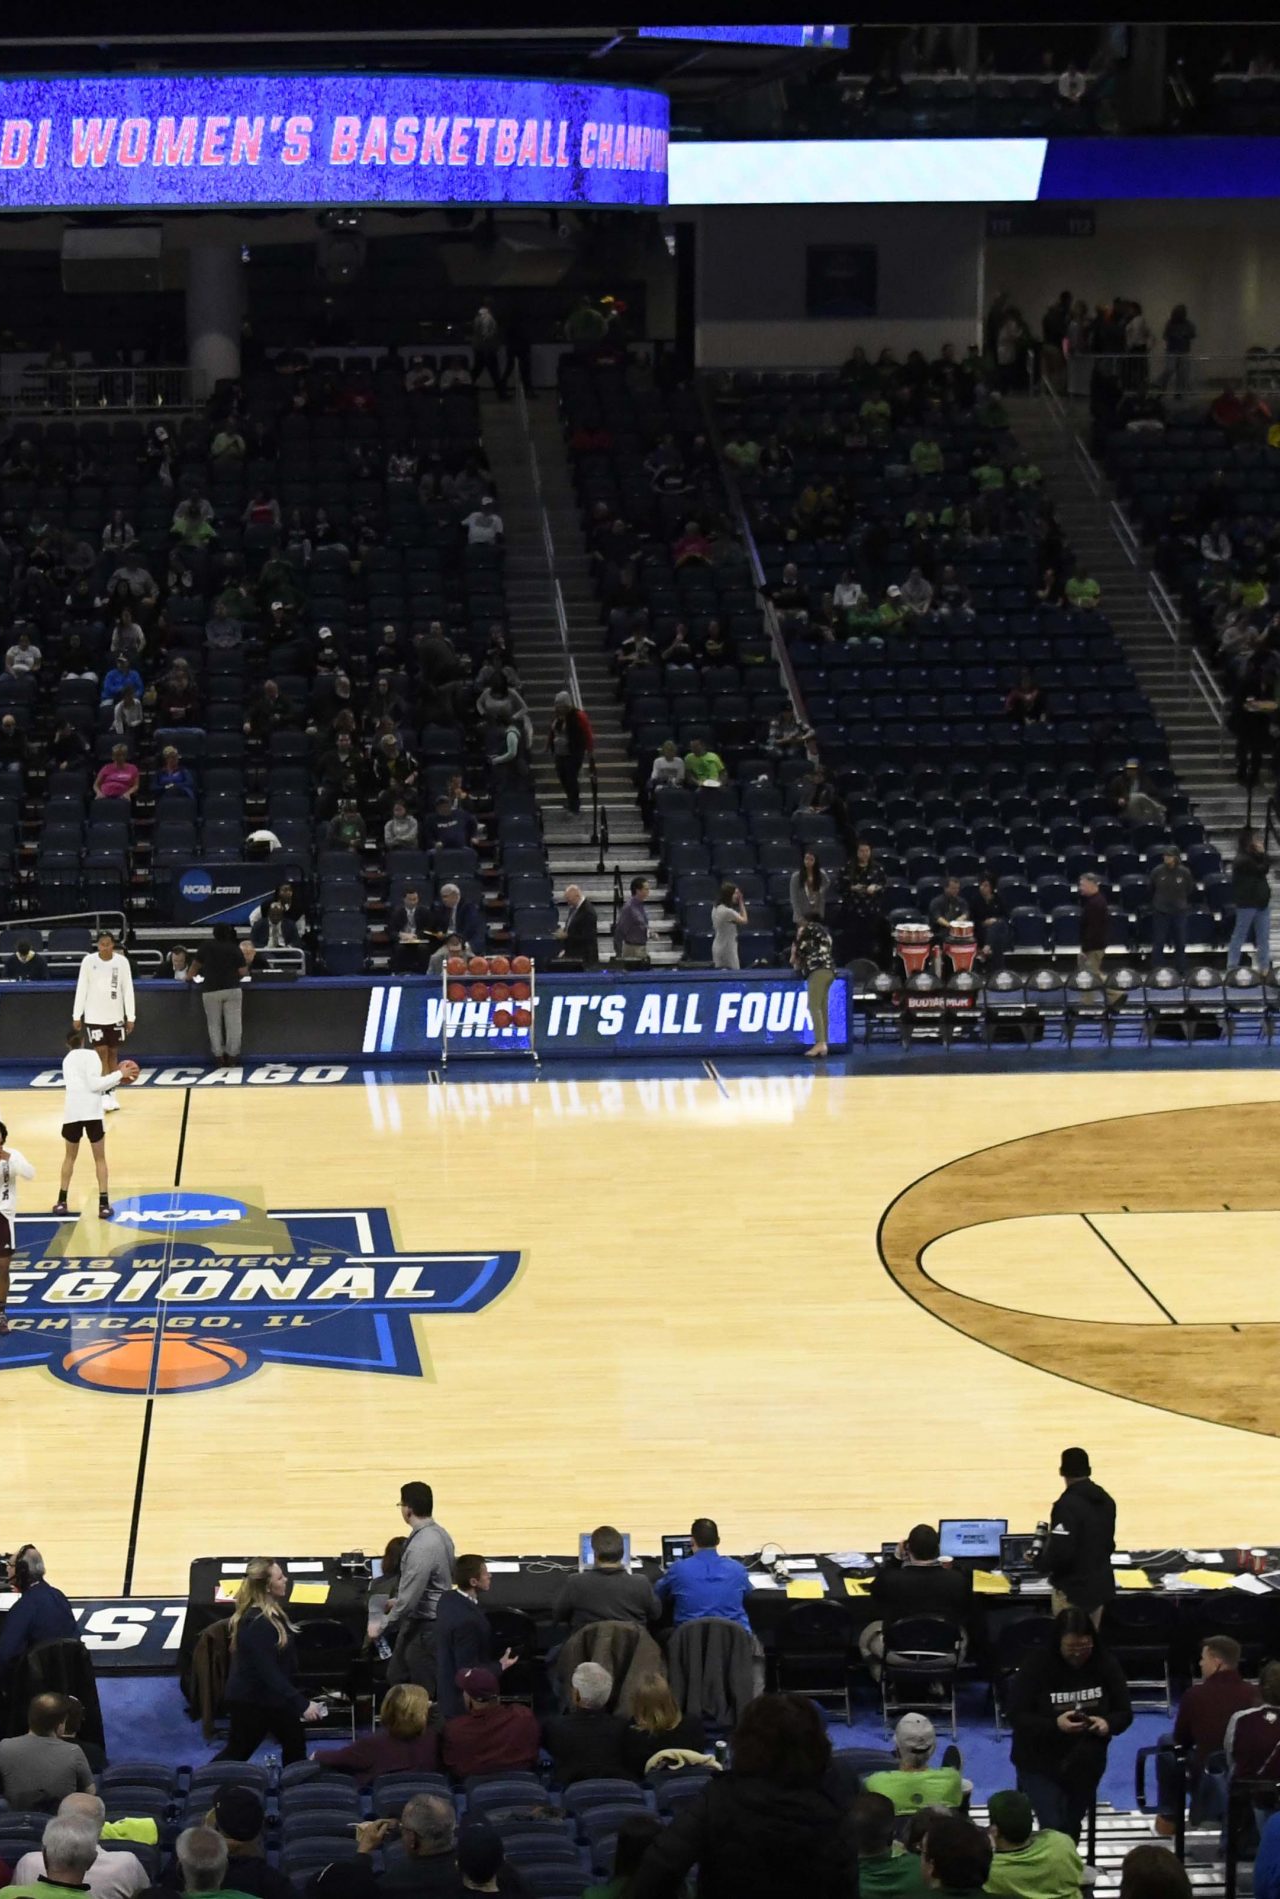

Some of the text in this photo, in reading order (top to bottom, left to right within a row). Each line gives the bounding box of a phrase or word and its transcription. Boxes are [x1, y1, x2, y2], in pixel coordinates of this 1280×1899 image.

[71, 116, 314, 169] WOMEN'S
[328, 116, 570, 168] BASKETBALL
[182, 885, 241, 894] NCAA.com
[547, 995, 627, 1036] IT'S
[634, 993, 703, 1034] ALL
[29, 1065, 349, 1087] CICAGO
[114, 1209, 241, 1222] NCAA
[8, 1255, 333, 1270] 2019 WOMEN'S
[6, 1314, 313, 1331] CHICAGO, IL
[1050, 1686, 1103, 1704] TERRIERS
